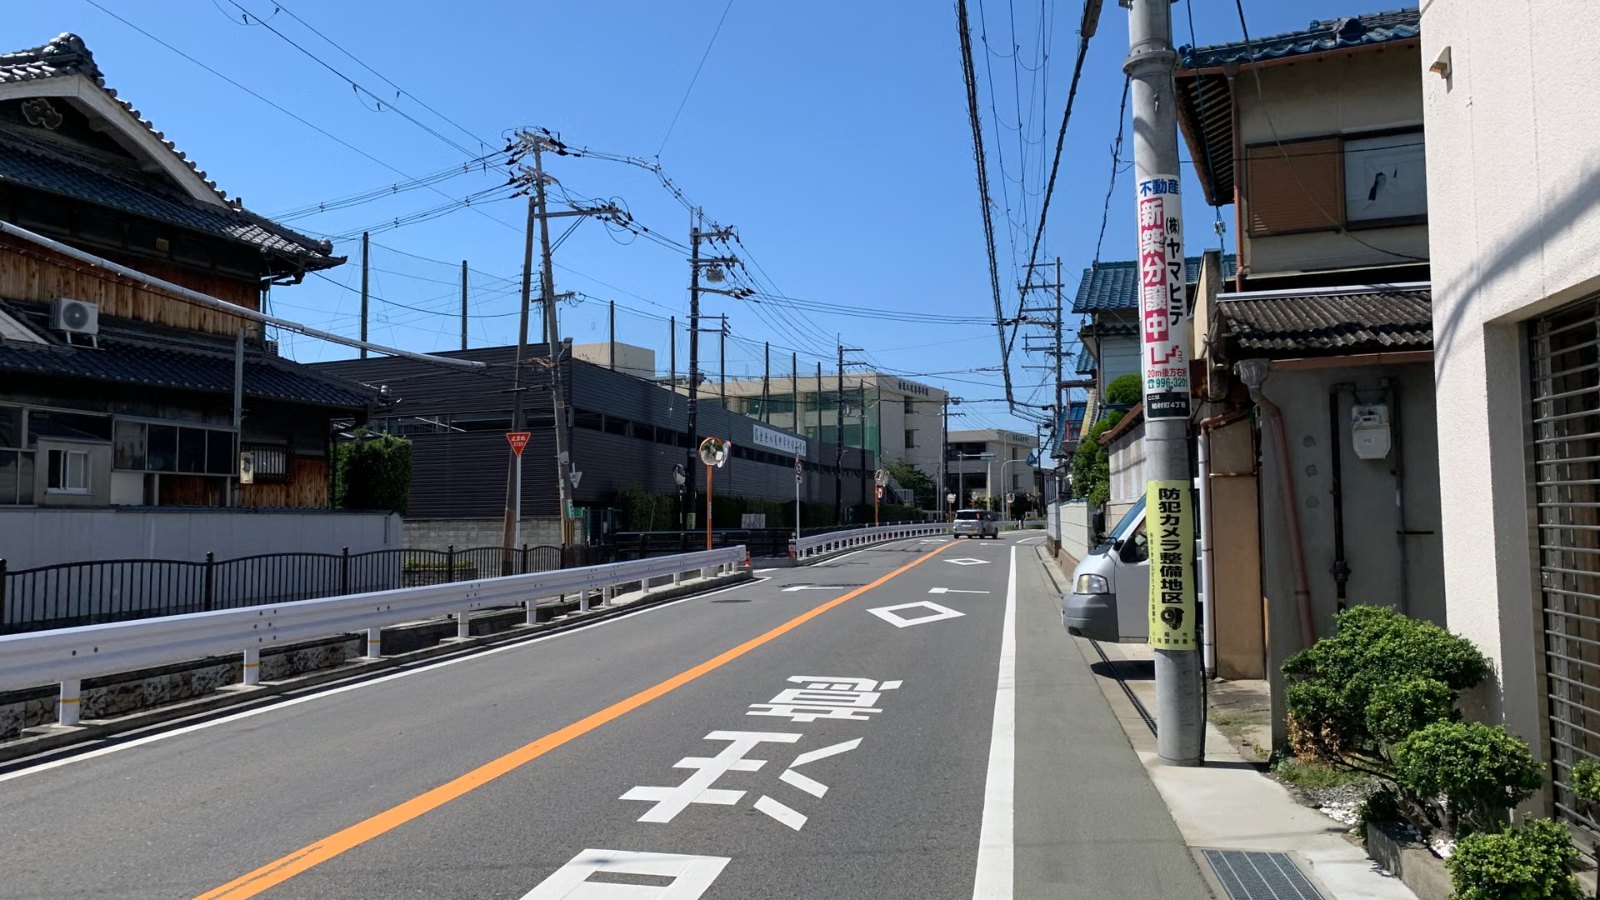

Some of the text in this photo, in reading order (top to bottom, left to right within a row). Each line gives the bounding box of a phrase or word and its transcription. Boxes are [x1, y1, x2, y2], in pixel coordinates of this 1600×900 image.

[1139, 178, 1180, 197] 不動産
[1141, 199, 1167, 340] 新築分譲中
[1165, 216, 1184, 326] (株)ヤマヒデ
[1158, 487, 1184, 605] 防犯カメラ整備地区
